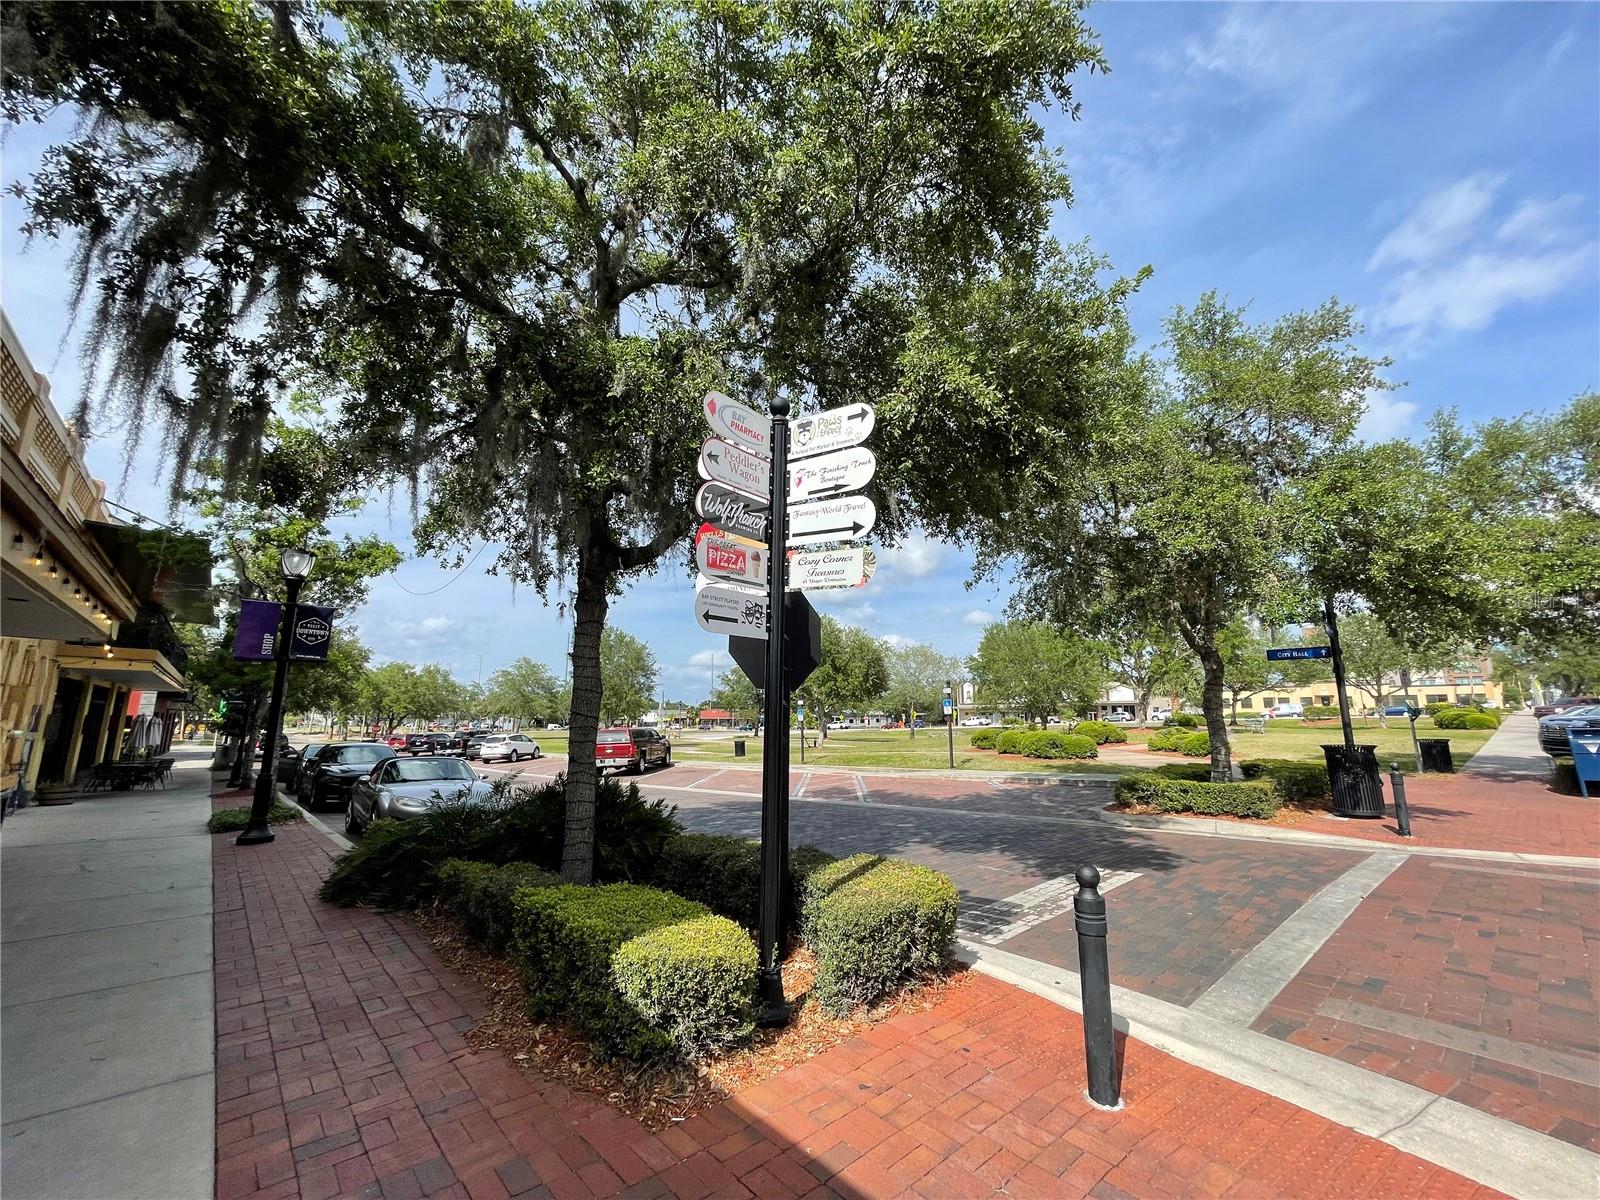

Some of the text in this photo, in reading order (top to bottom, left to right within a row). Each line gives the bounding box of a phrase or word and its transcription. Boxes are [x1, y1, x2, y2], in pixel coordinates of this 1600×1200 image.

[731, 411, 746, 424] BAY
[817, 415, 842, 429] Paws
[730, 420, 765, 442] PHARMACY
[724, 446, 765, 475] Peddler's
[804, 457, 872, 479] The Finishing Touch
[728, 460, 760, 485] Wagon
[820, 474, 846, 484] Boutique
[792, 501, 866, 520] Fantasy World Travel
[708, 548, 746, 570] PIZZA
[798, 553, 854, 568] Cozy Corner
[806, 567, 845, 578] Treasures
[296, 628, 329, 636] DOWNTOWN
[261, 633, 275, 655] SHOP
